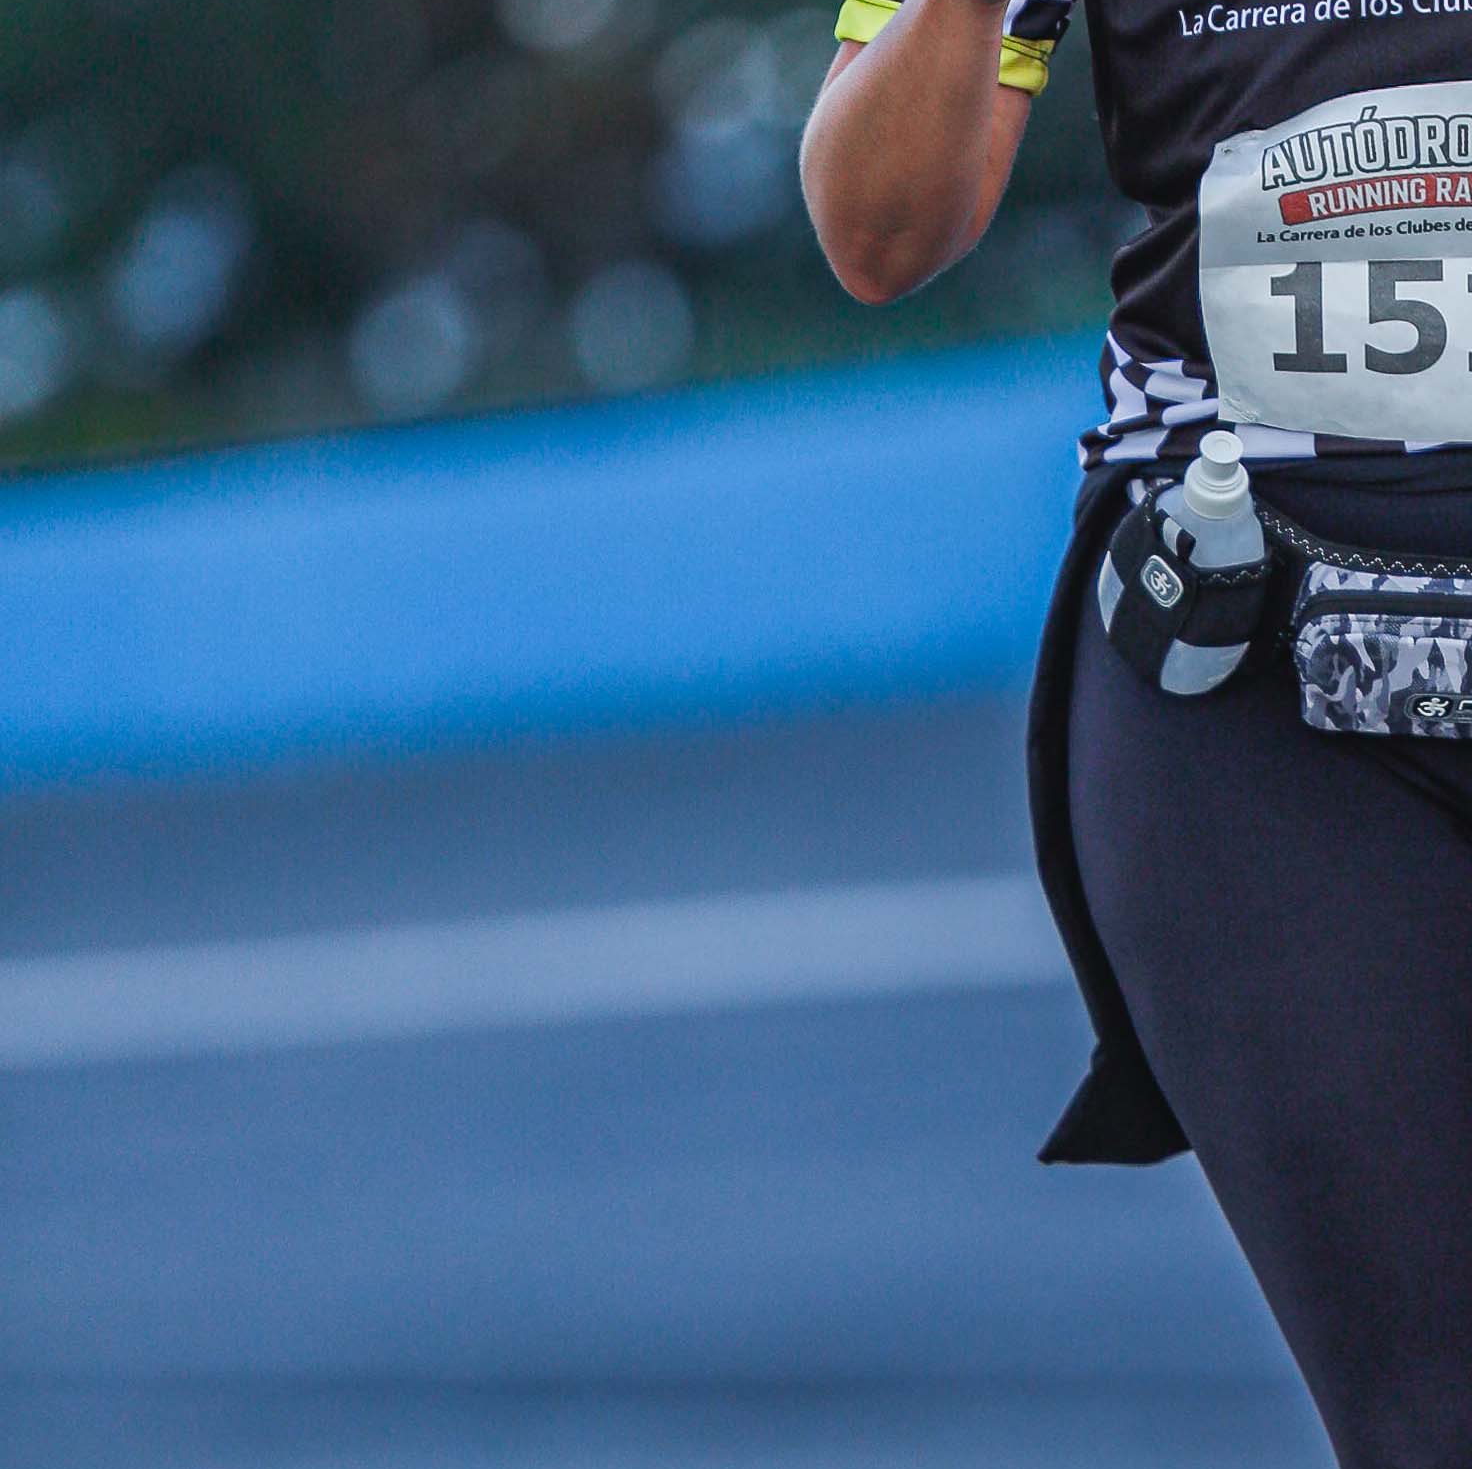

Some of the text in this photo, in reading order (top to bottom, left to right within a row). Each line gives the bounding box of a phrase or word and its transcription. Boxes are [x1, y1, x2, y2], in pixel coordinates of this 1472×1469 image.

[1178, 9, 1204, 37] La
[1207, 3, 1306, 32] Carrera
[1307, 177, 1427, 218] RUNNING
[1256, 230, 1276, 244] La
[1279, 228, 1340, 243] Carrera
[1343, 224, 1366, 239] de
[1369, 222, 1393, 237] los
[1396, 219, 1451, 235] Clubes
